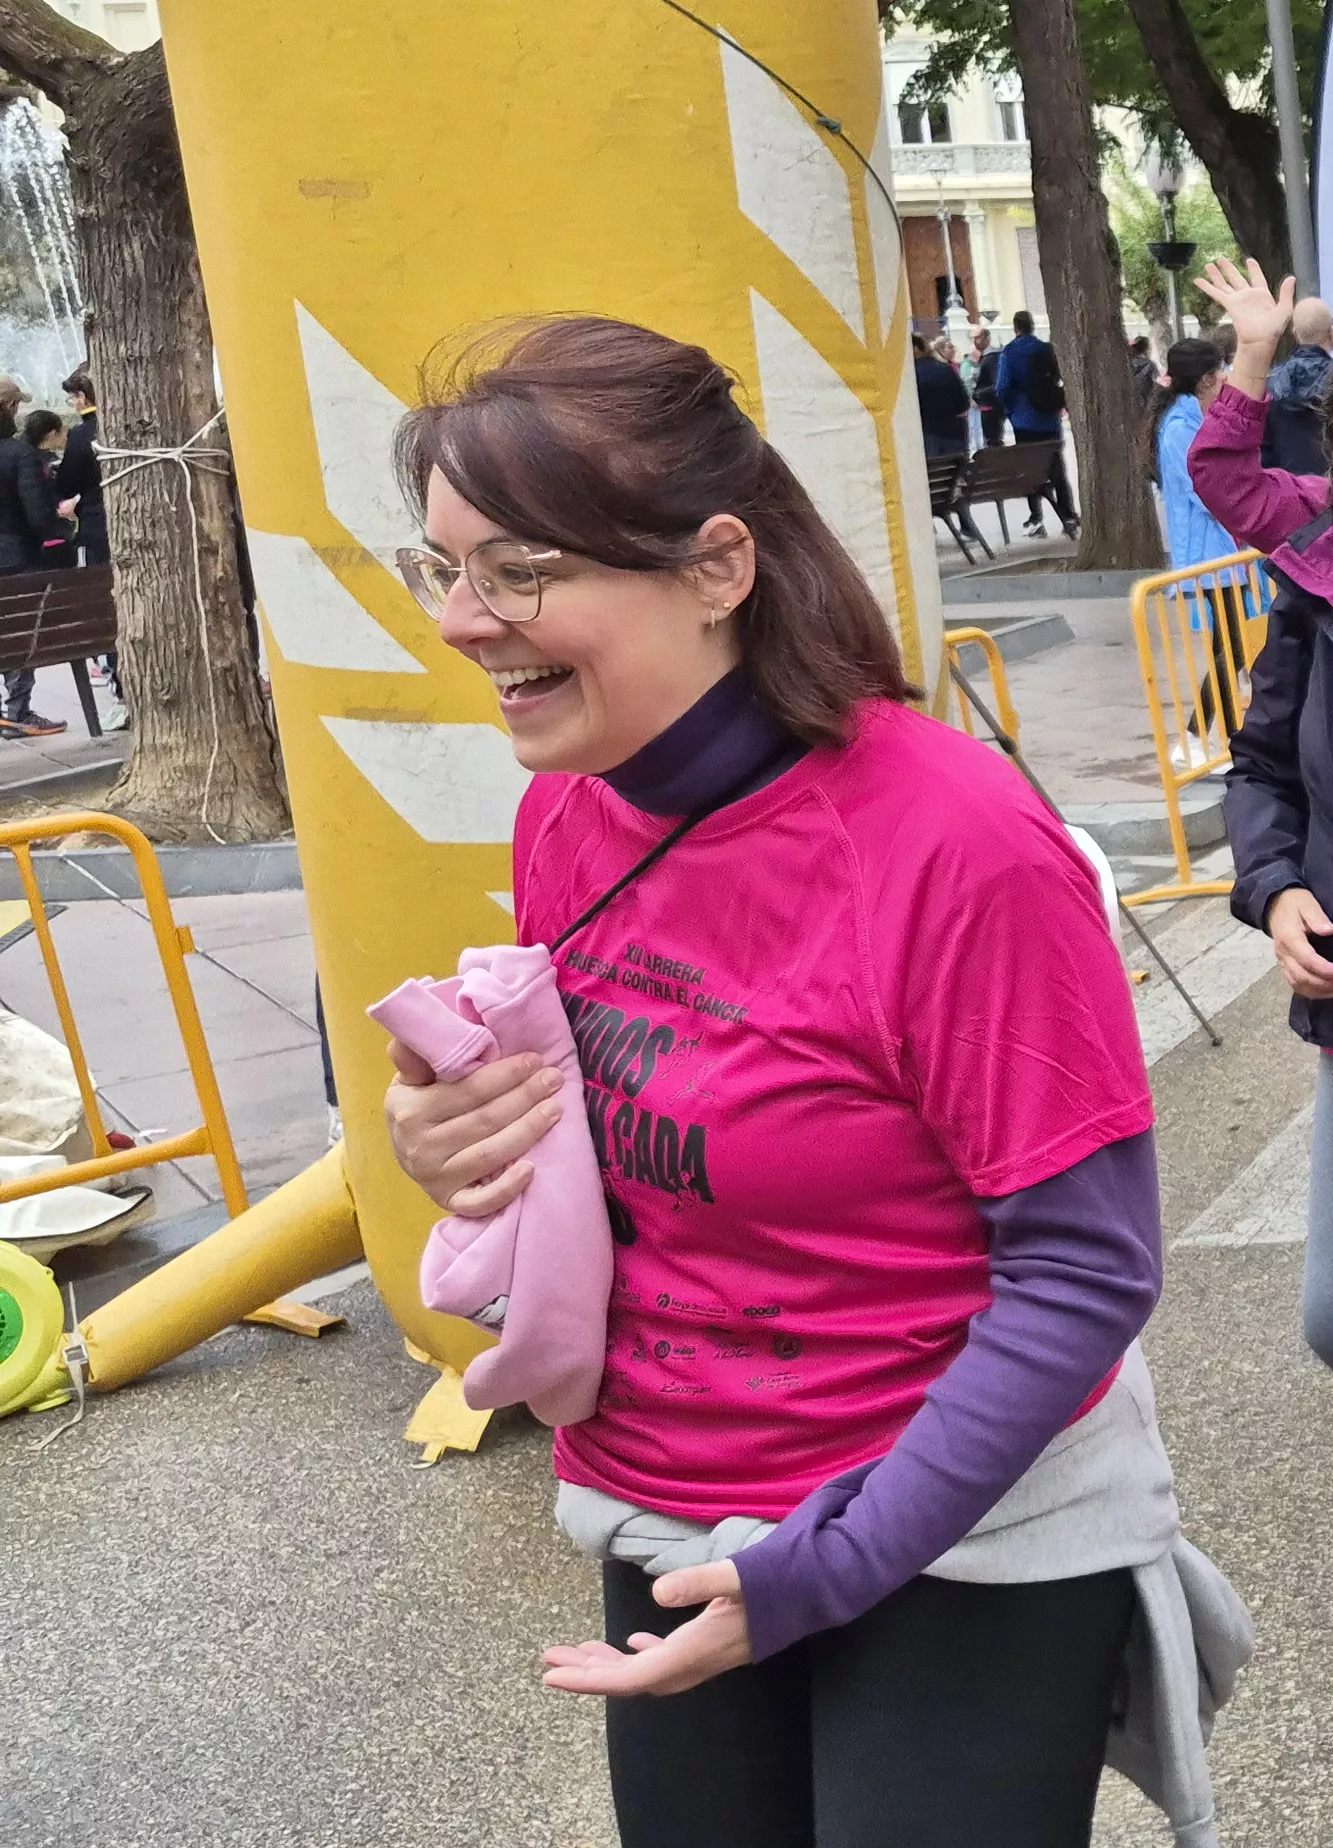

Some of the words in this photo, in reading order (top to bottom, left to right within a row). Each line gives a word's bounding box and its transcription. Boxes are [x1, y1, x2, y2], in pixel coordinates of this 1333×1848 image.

[564, 949, 619, 983] HUESCA
[622, 969, 675, 1001] CONTRA
[676, 987, 691, 1008] EL
[611, 1100, 716, 1205] CADA
